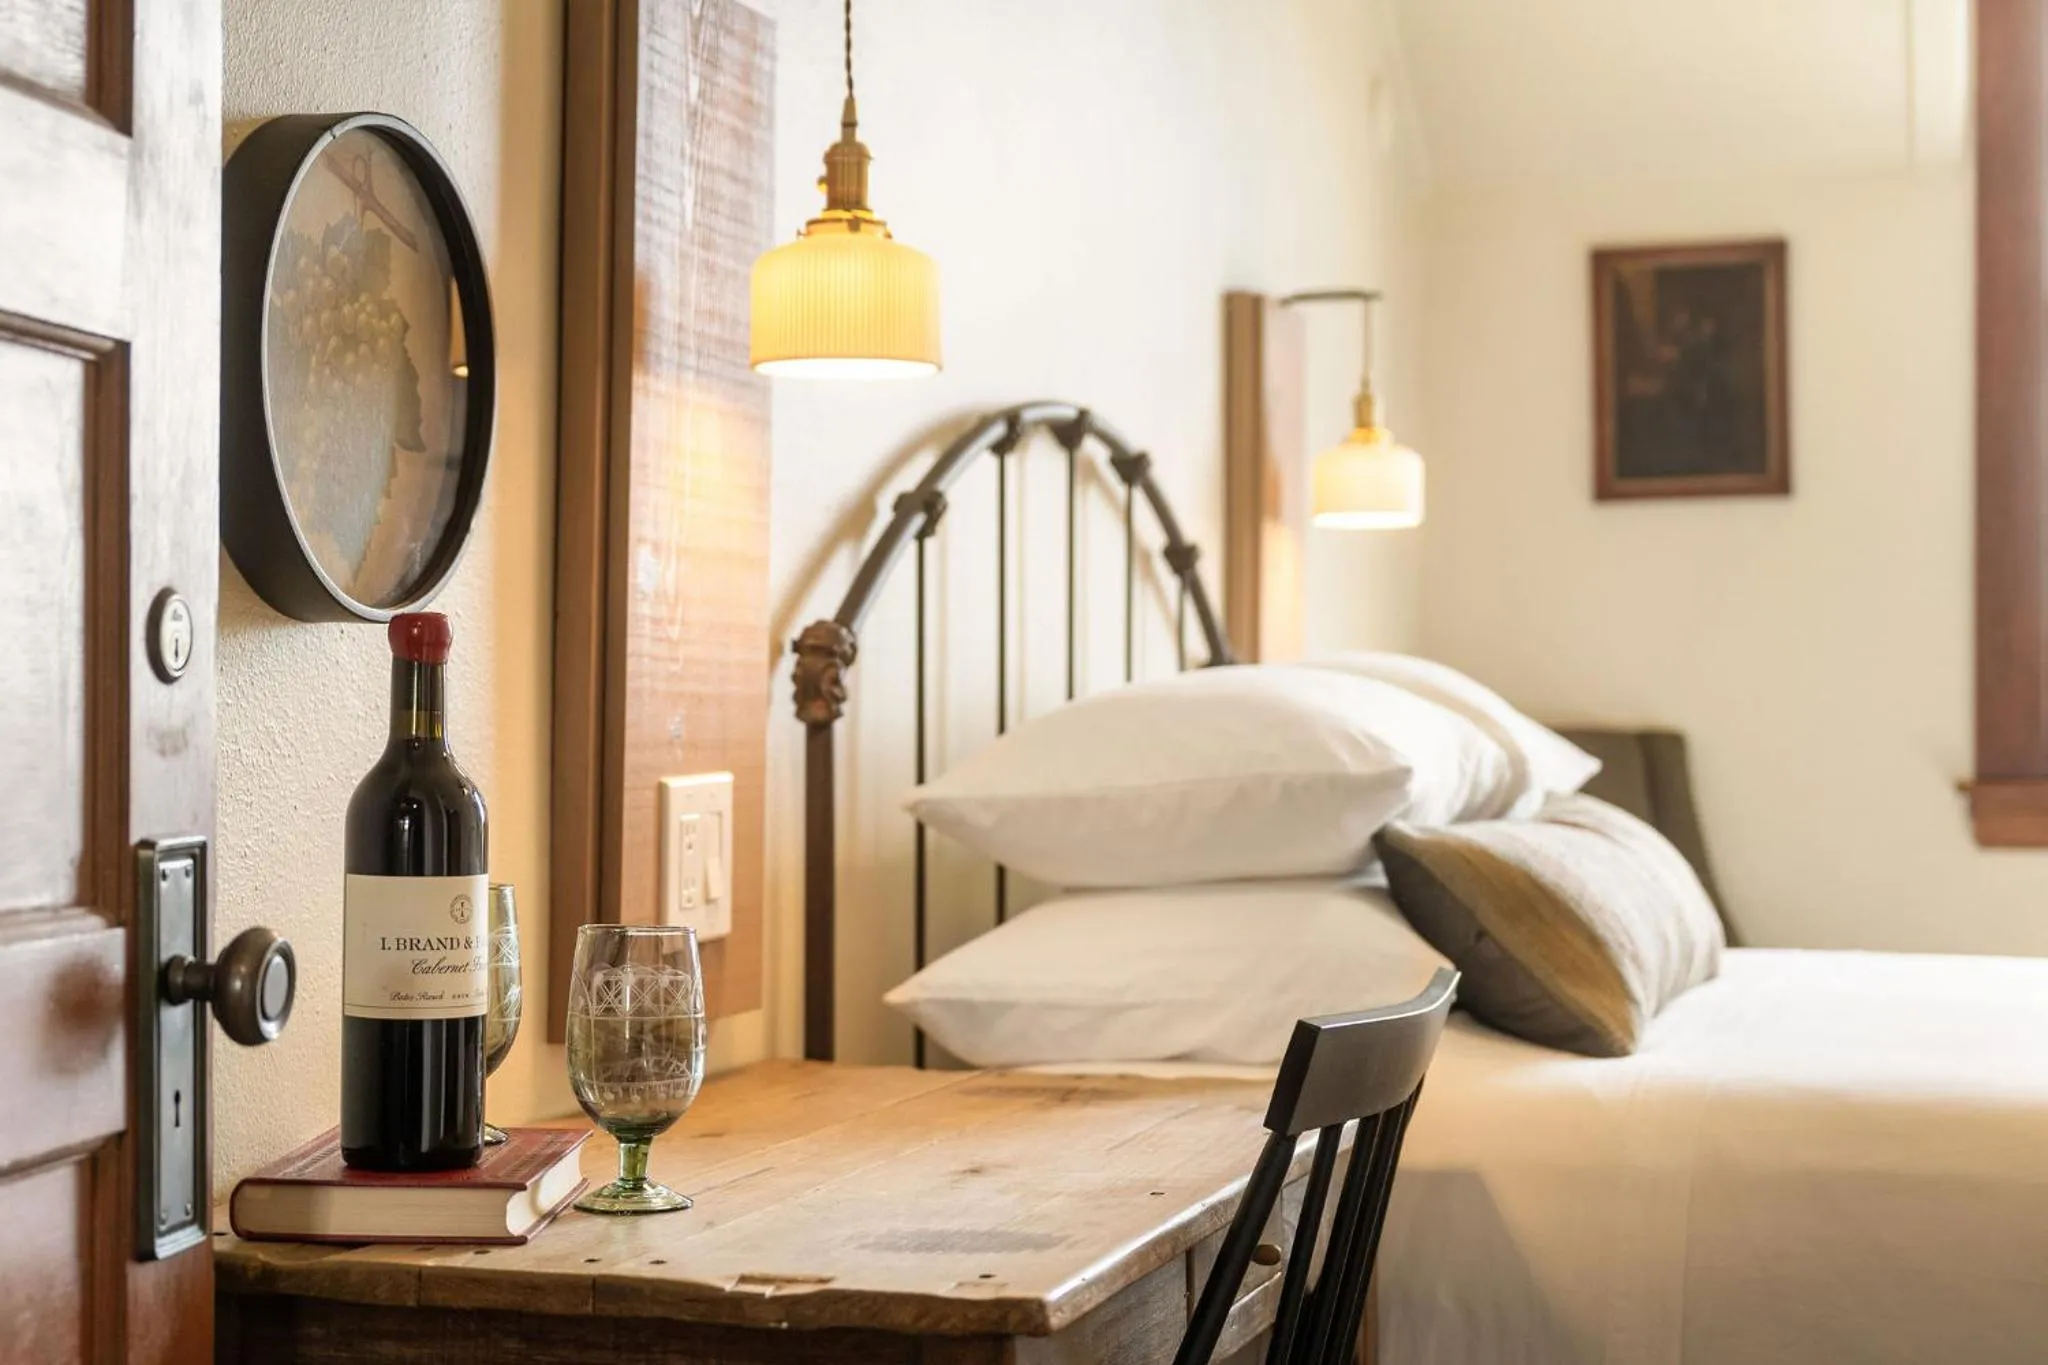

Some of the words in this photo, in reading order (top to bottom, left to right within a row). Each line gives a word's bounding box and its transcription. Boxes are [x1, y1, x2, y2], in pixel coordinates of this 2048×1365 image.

[380, 937, 391, 951] I.
[395, 937, 460, 951] BRAND
[464, 936, 473, 949] &
[411, 956, 470, 975] Cabernet
